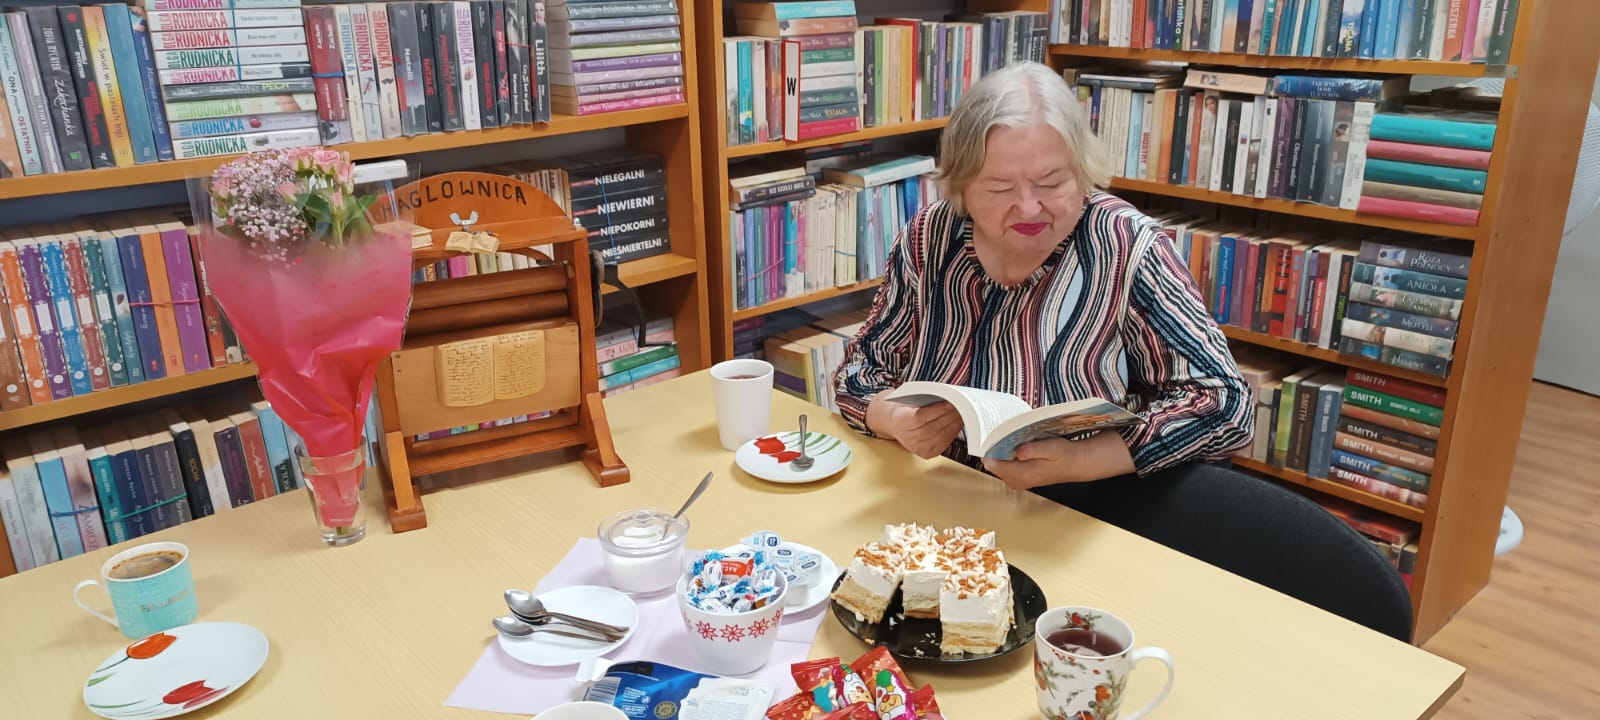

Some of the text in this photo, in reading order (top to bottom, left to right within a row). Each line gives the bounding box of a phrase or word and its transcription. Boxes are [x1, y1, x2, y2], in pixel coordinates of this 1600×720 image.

[172, 11, 228, 30] RUDNICKA
[176, 31, 231, 48] RUDNICKA
[341, 25, 355, 72] RUDNICKA
[354, 25, 373, 72] RUDNICKA
[373, 22, 393, 69] RUDNICKA
[458, 20, 475, 65] RUDNICKA
[180, 50, 235, 68] RUDNICKA
[404, 48, 414, 80] Natalii
[535, 39, 545, 76] Lilith
[99, 48, 109, 71] Świat
[107, 83, 121, 122] pastelach
[183, 68, 238, 84] RUDNICKA
[787, 78, 796, 96] W
[190, 99, 243, 118] RUDNICKA
[18, 116, 32, 154] OSTATNIA
[192, 118, 245, 136] RUDNICKA
[194, 137, 248, 156] RUDNICKA
[595, 169, 645, 186] NIELEGALNI
[597, 195, 654, 215] NIEWIERNI
[600, 218, 655, 236] NIEPOKORNI
[602, 238, 662, 258] NIEŚMIERTELNI
[1354, 372, 1386, 387] SMITH
[1299, 392, 1310, 423] SMITH
[1350, 391, 1382, 406] SMITH
[1347, 424, 1378, 439] SMITH
[1343, 438, 1373, 454] SMITH
[1339, 455, 1371, 471] SMITH
[1337, 470, 1369, 485] SMITH
